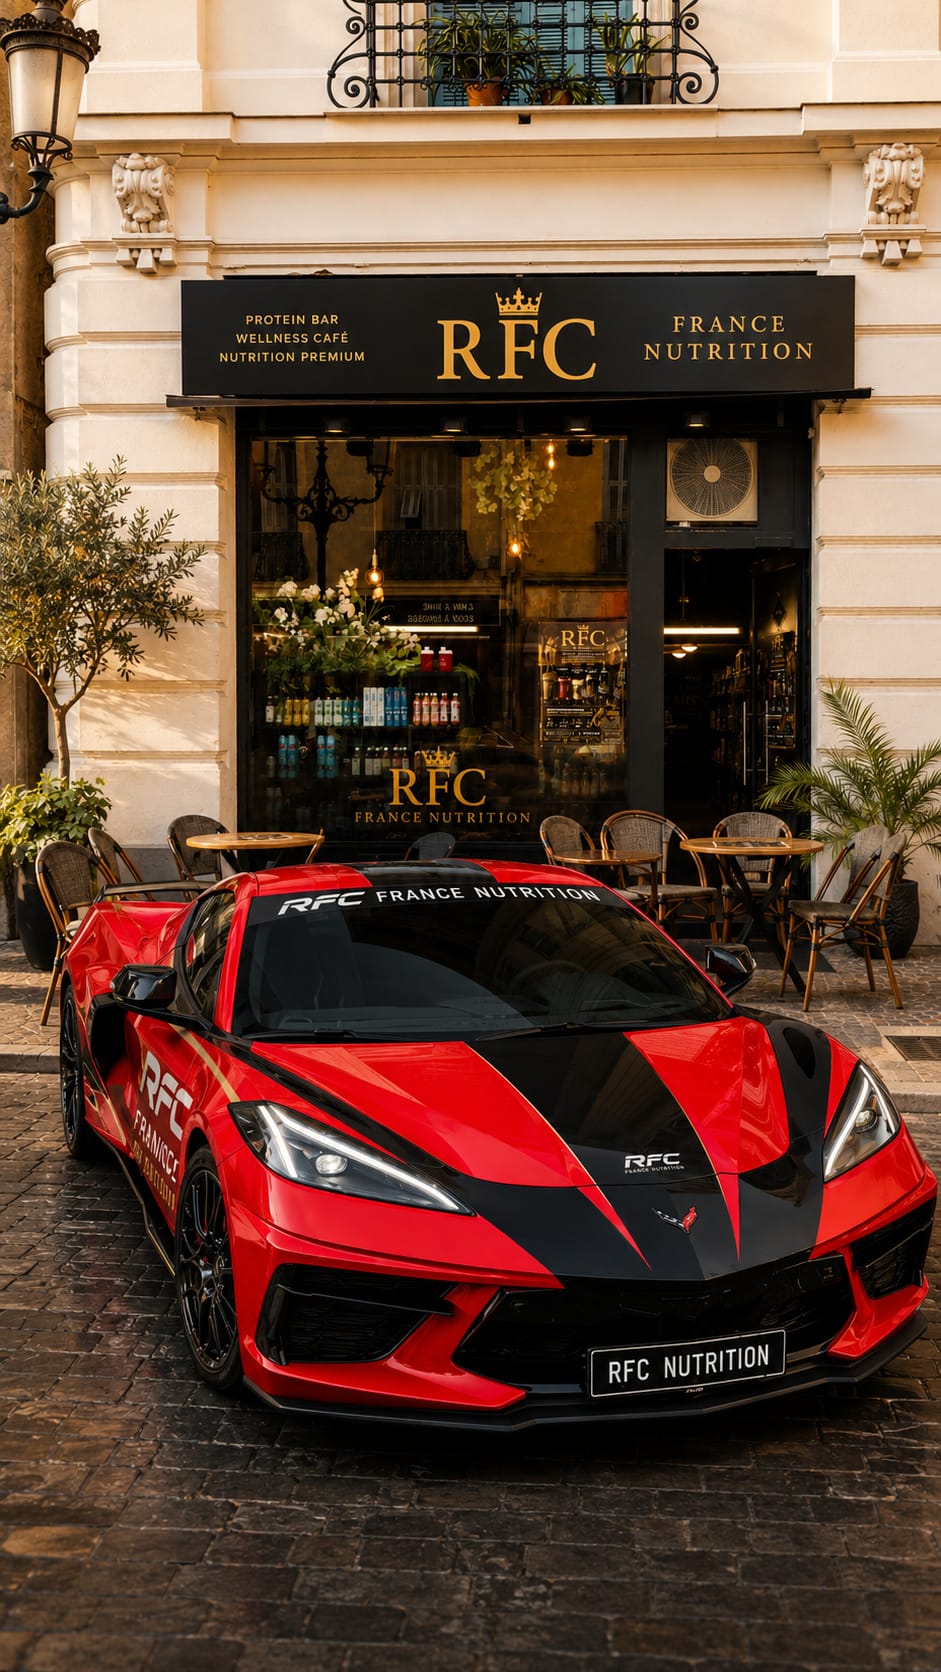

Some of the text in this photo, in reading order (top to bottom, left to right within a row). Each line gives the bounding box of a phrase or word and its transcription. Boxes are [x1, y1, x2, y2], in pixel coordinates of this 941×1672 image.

[245, 314, 339, 325] PROTEIN BAR
[672, 315, 785, 333] FRANCE
[235, 330, 349, 344] WELLNESS CAFÉ
[219, 351, 365, 363] NUTRITION PREMIUM
[436, 317, 597, 381] RFC
[644, 342, 813, 361] NUTRITION
[560, 630, 606, 647] RFC
[388, 768, 487, 807] RFC
[354, 811, 531, 823] FRANCE NUTRITION
[277, 886, 600, 916] RFC FRANCE NUTRITION
[139, 1050, 194, 1142] RFC
[624, 1152, 681, 1169] RFC
[608, 1343, 770, 1385] RFC NUTRITION
